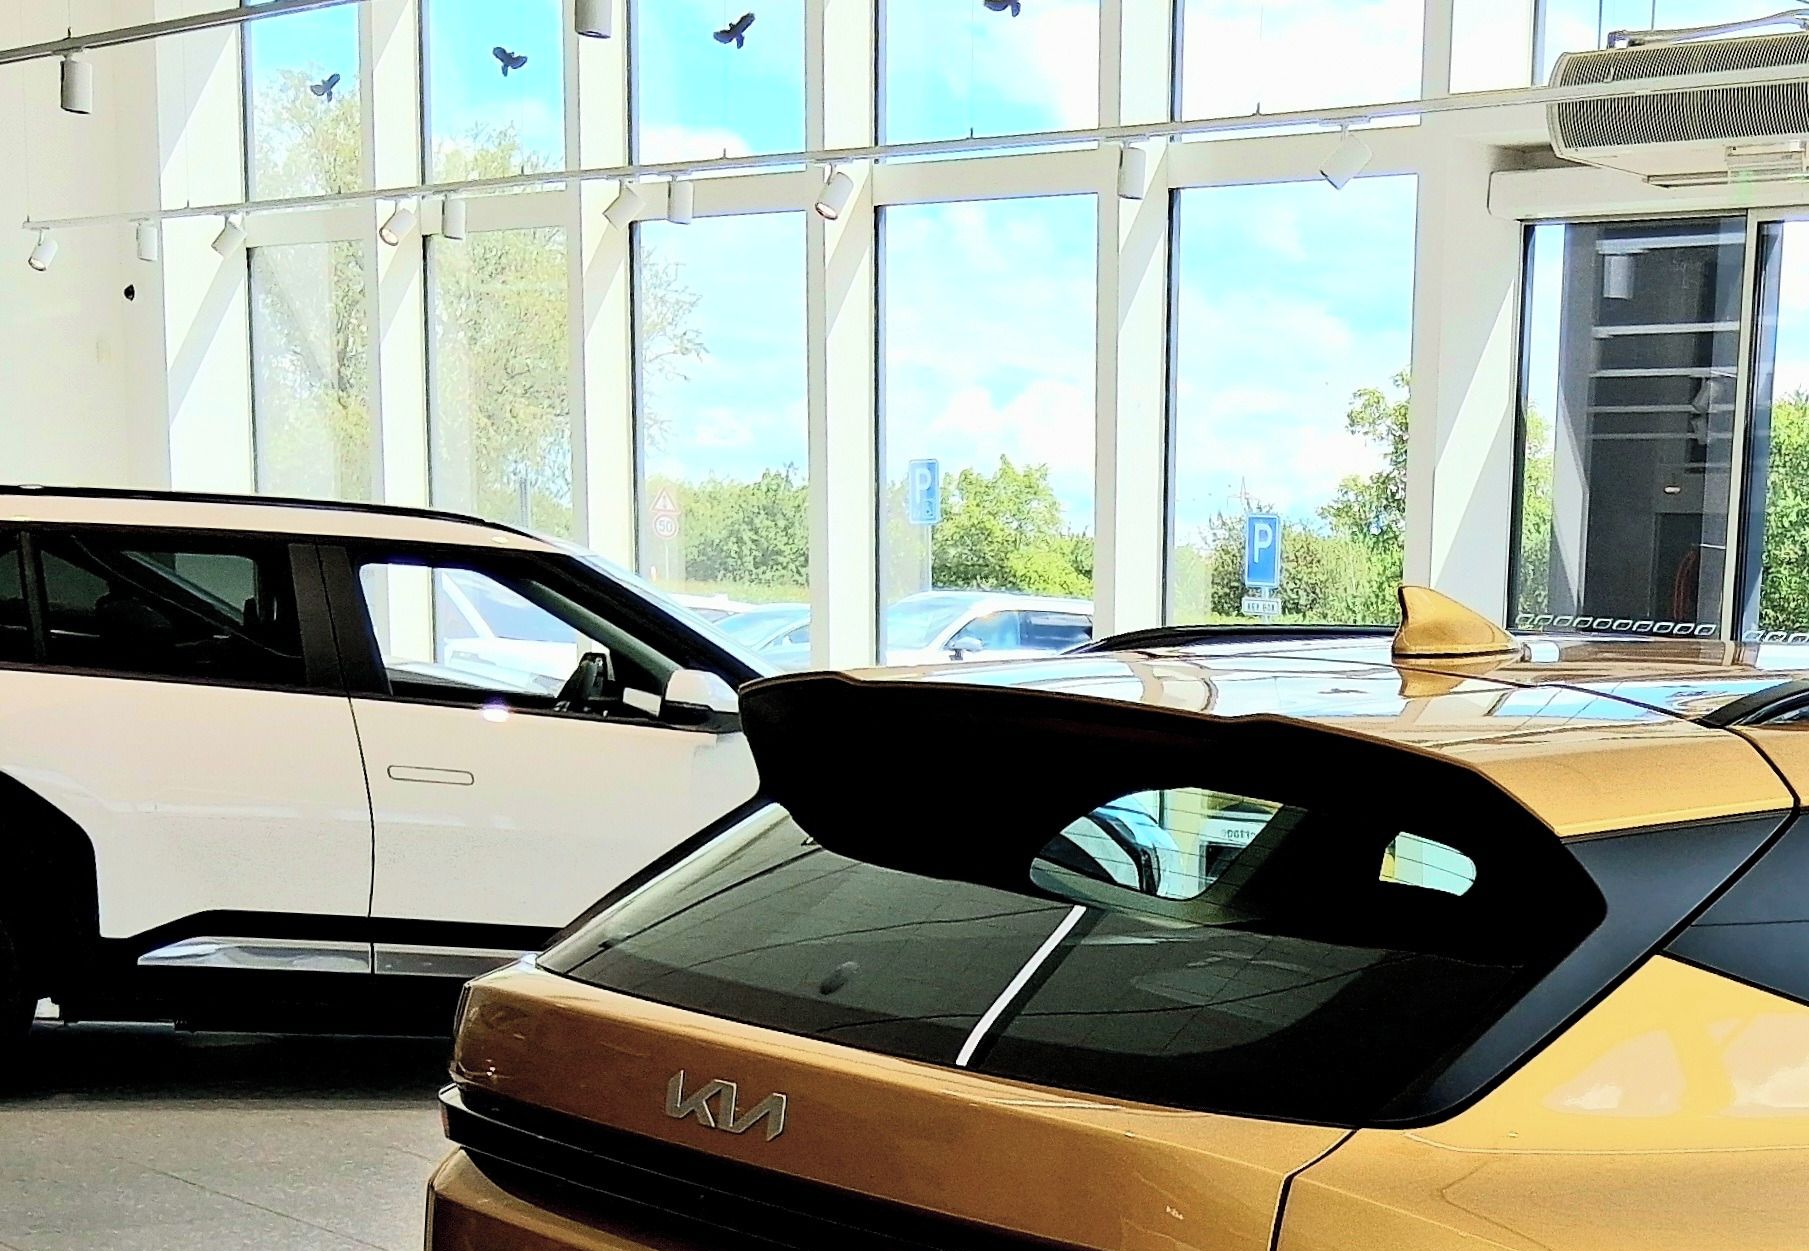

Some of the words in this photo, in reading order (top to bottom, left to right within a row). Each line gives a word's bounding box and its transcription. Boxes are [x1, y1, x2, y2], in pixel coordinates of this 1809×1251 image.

[915, 467, 931, 504] P
[658, 519, 673, 532] 50
[1253, 523, 1273, 563] P
[665, 1069, 788, 1141] KIA
